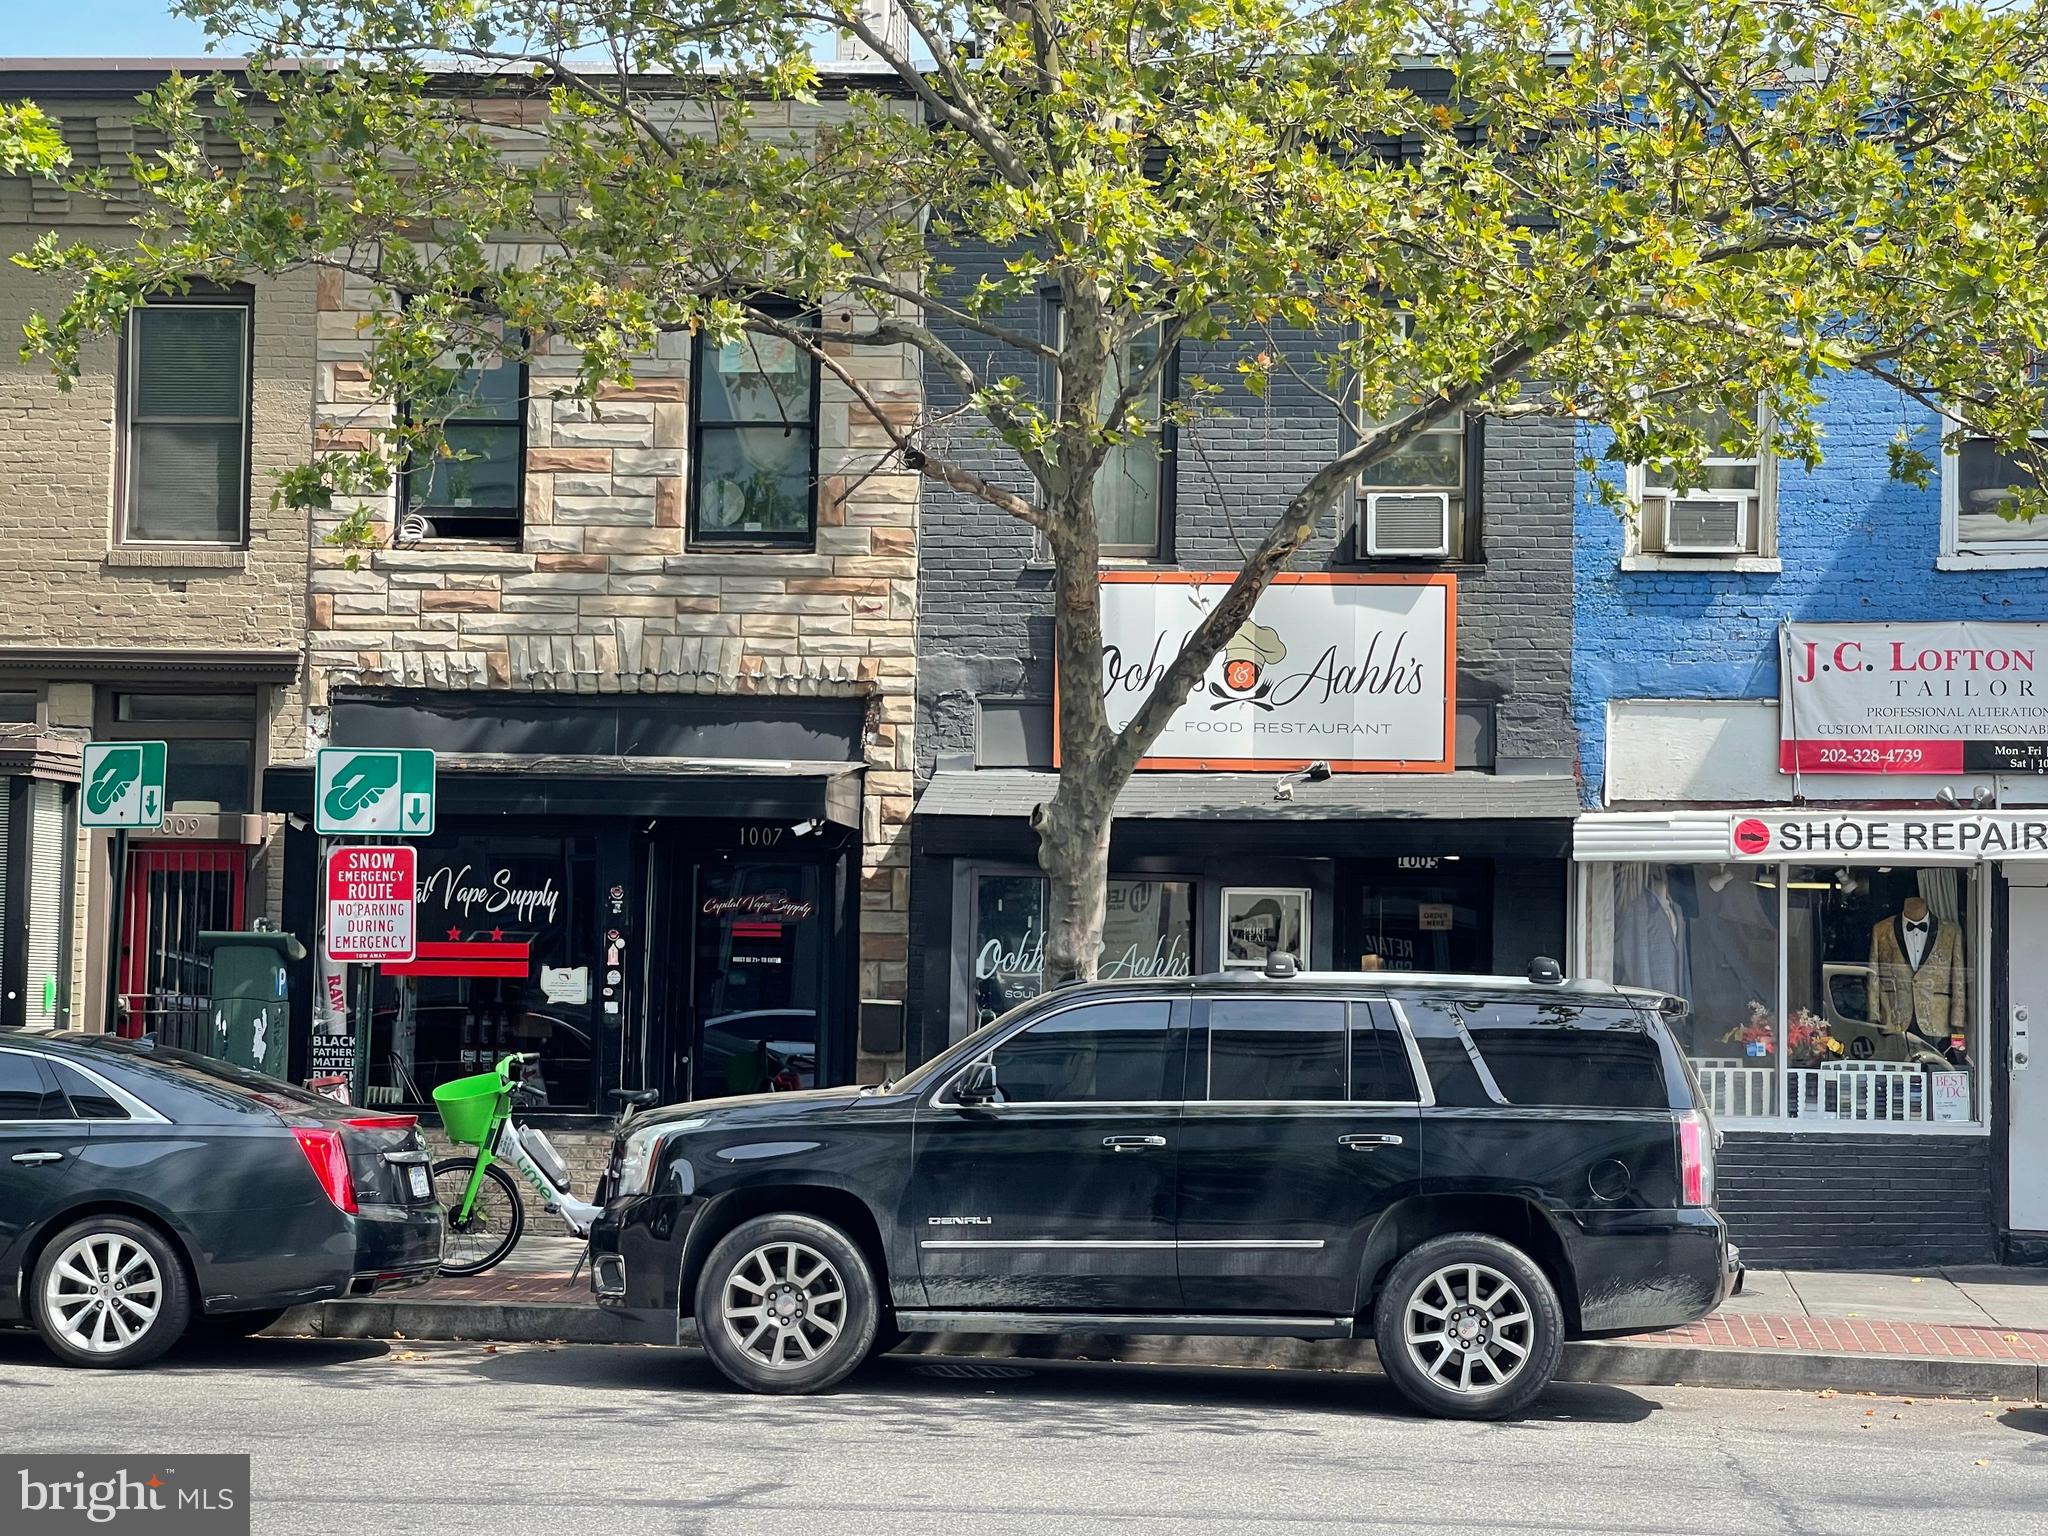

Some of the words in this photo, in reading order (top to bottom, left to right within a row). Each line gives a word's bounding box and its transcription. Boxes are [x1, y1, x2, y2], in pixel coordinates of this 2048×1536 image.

[1270, 630, 1424, 706] Aahh's
[1797, 641, 1874, 683] J.C.
[1889, 641, 2035, 671] LOFTON
[1890, 680, 2035, 697] TAILOR
[1867, 707, 1965, 718] PROFESSIONAL
[1118, 721, 1175, 732] SL
[1185, 721, 1243, 733] FOOD
[1253, 722, 1393, 735] RESTAURANT
[1817, 724, 1873, 735] CUSTOM
[1876, 724, 1950, 735] TAILORING
[1953, 724, 1971, 735] AT
[1820, 748, 1923, 763] 202-328-4739
[1995, 746, 2018, 755] Mon
[2028, 746, 2042, 755] Fri
[2010, 758, 2027, 768] Sat
[151, 817, 200, 836] 009
[740, 827, 783, 846] 1007
[1779, 822, 1889, 851] SHOE
[1904, 822, 2048, 851] REPAIR
[349, 853, 395, 869] SNOW
[338, 871, 404, 882] EMERGENCY
[348, 884, 394, 899] ROUTE
[430, 865, 488, 918] Vape
[486, 869, 559, 924] Supply
[338, 903, 352, 916] NO
[357, 903, 404, 916] PARKING
[703, 897, 742, 914] Capital
[772, 898, 811, 917] Supply
[348, 920, 394, 933] DURING
[335, 936, 406, 949] EMERGENCY
[278, 967, 287, 996] P
[327, 974, 345, 1013] RAW
[313, 1036, 355, 1047] BLACK
[1936, 1075, 1965, 1087] BEST
[517, 1156, 552, 1200] Lime
[928, 1216, 992, 1225] DENALI
